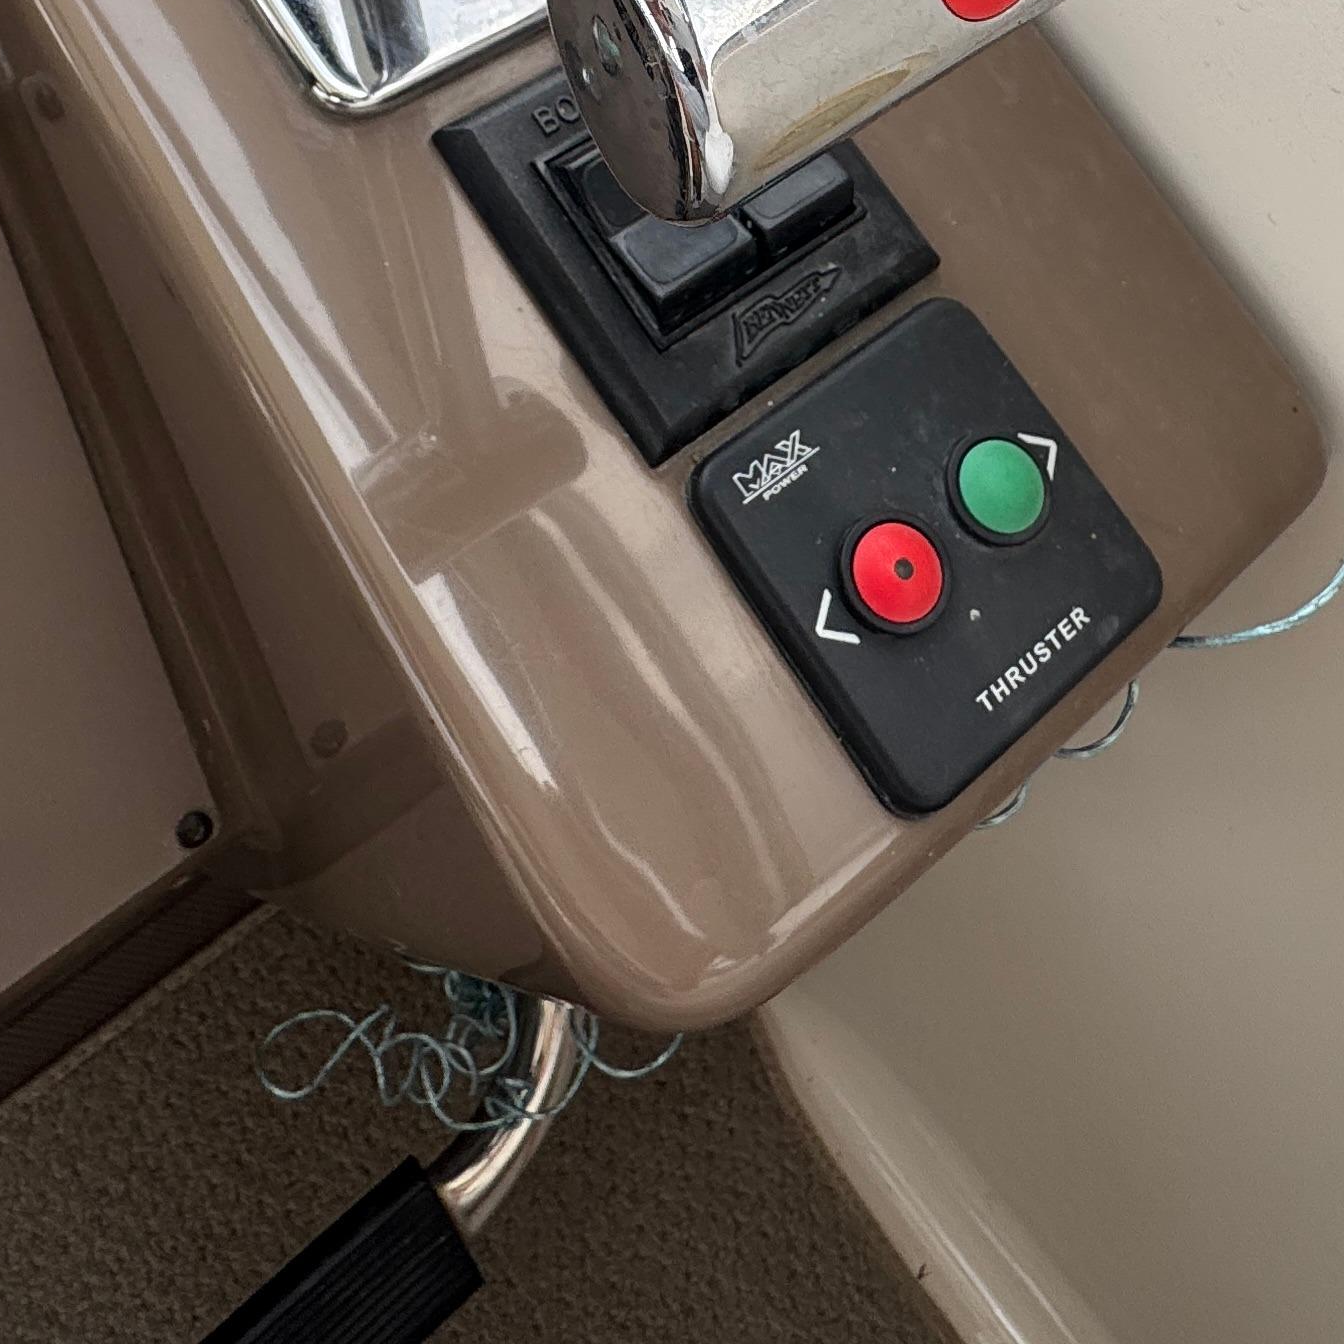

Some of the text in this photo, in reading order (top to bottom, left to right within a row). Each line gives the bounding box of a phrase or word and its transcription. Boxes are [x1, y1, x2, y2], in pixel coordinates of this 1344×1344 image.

[531, 95, 582, 137] BO
[732, 429, 813, 498] MAX
[762, 463, 810, 501] POWER
[975, 605, 1093, 715] THRUSTER
